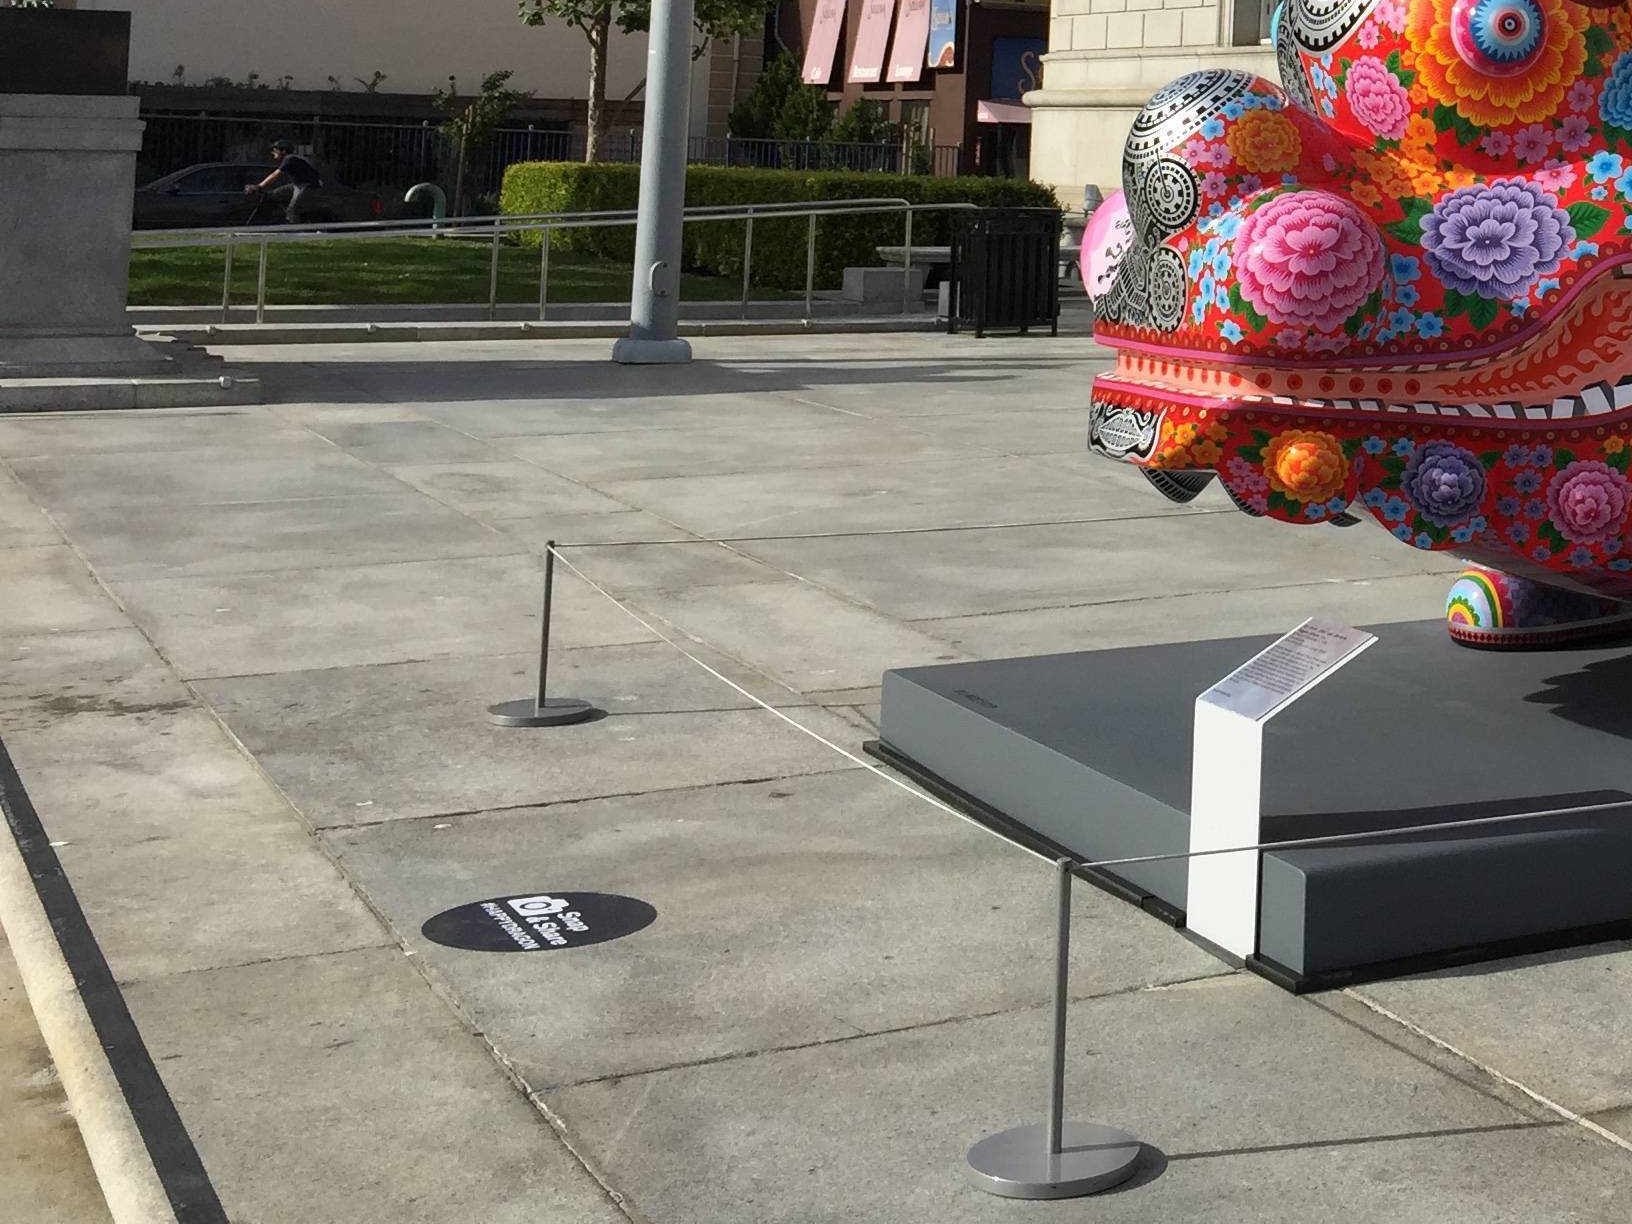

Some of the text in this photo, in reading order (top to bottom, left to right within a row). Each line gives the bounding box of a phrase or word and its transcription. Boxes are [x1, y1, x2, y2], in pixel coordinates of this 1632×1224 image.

[525, 916, 567, 946] & Share
[557, 911, 589, 931] Snap
